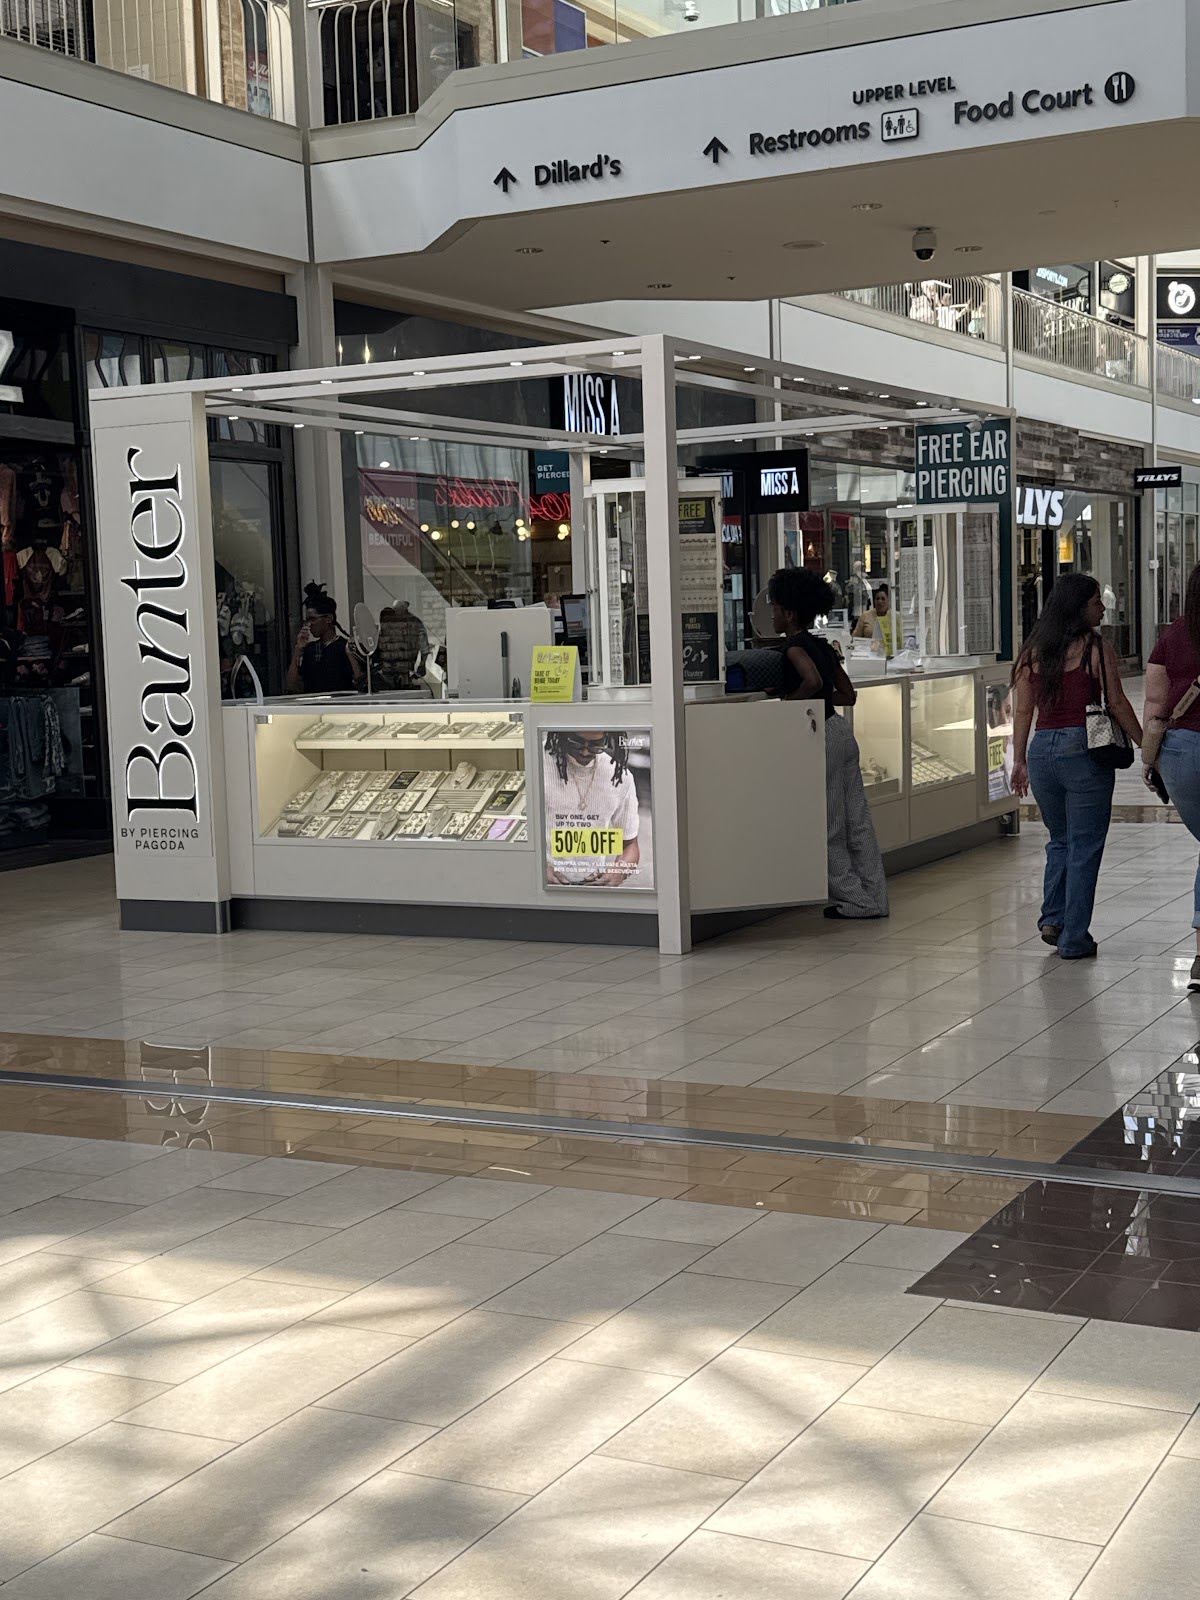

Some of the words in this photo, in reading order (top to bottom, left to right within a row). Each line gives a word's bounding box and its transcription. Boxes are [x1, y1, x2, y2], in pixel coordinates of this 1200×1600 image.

[853, 84, 904, 105] UPPER
[909, 76, 956, 97] LEVEL
[954, 91, 1014, 124] Food
[1021, 83, 1093, 114] Court
[750, 121, 870, 155] Restrooms
[534, 154, 622, 186] Dillard's
[564, 374, 606, 436] MISS
[610, 379, 621, 436] A
[918, 433, 964, 465] FREE
[970, 430, 1007, 461] EAR
[537, 464, 553, 472] GET
[1136, 473, 1179, 483] TILLYS
[761, 472, 788, 496] MISS
[791, 471, 799, 494] A
[918, 465, 1007, 500] PIERCING
[679, 502, 701, 517] FREE
[1016, 486, 1064, 526] LLYS
[368, 533, 414, 546] BEAUTIFUL
[119, 446, 200, 823] Banter
[989, 743, 1002, 768] FREE
[121, 828, 135, 837] BY
[140, 828, 199, 838] PIERCING
[135, 840, 185, 850] PAGODA
[555, 830, 586, 854] 50%
